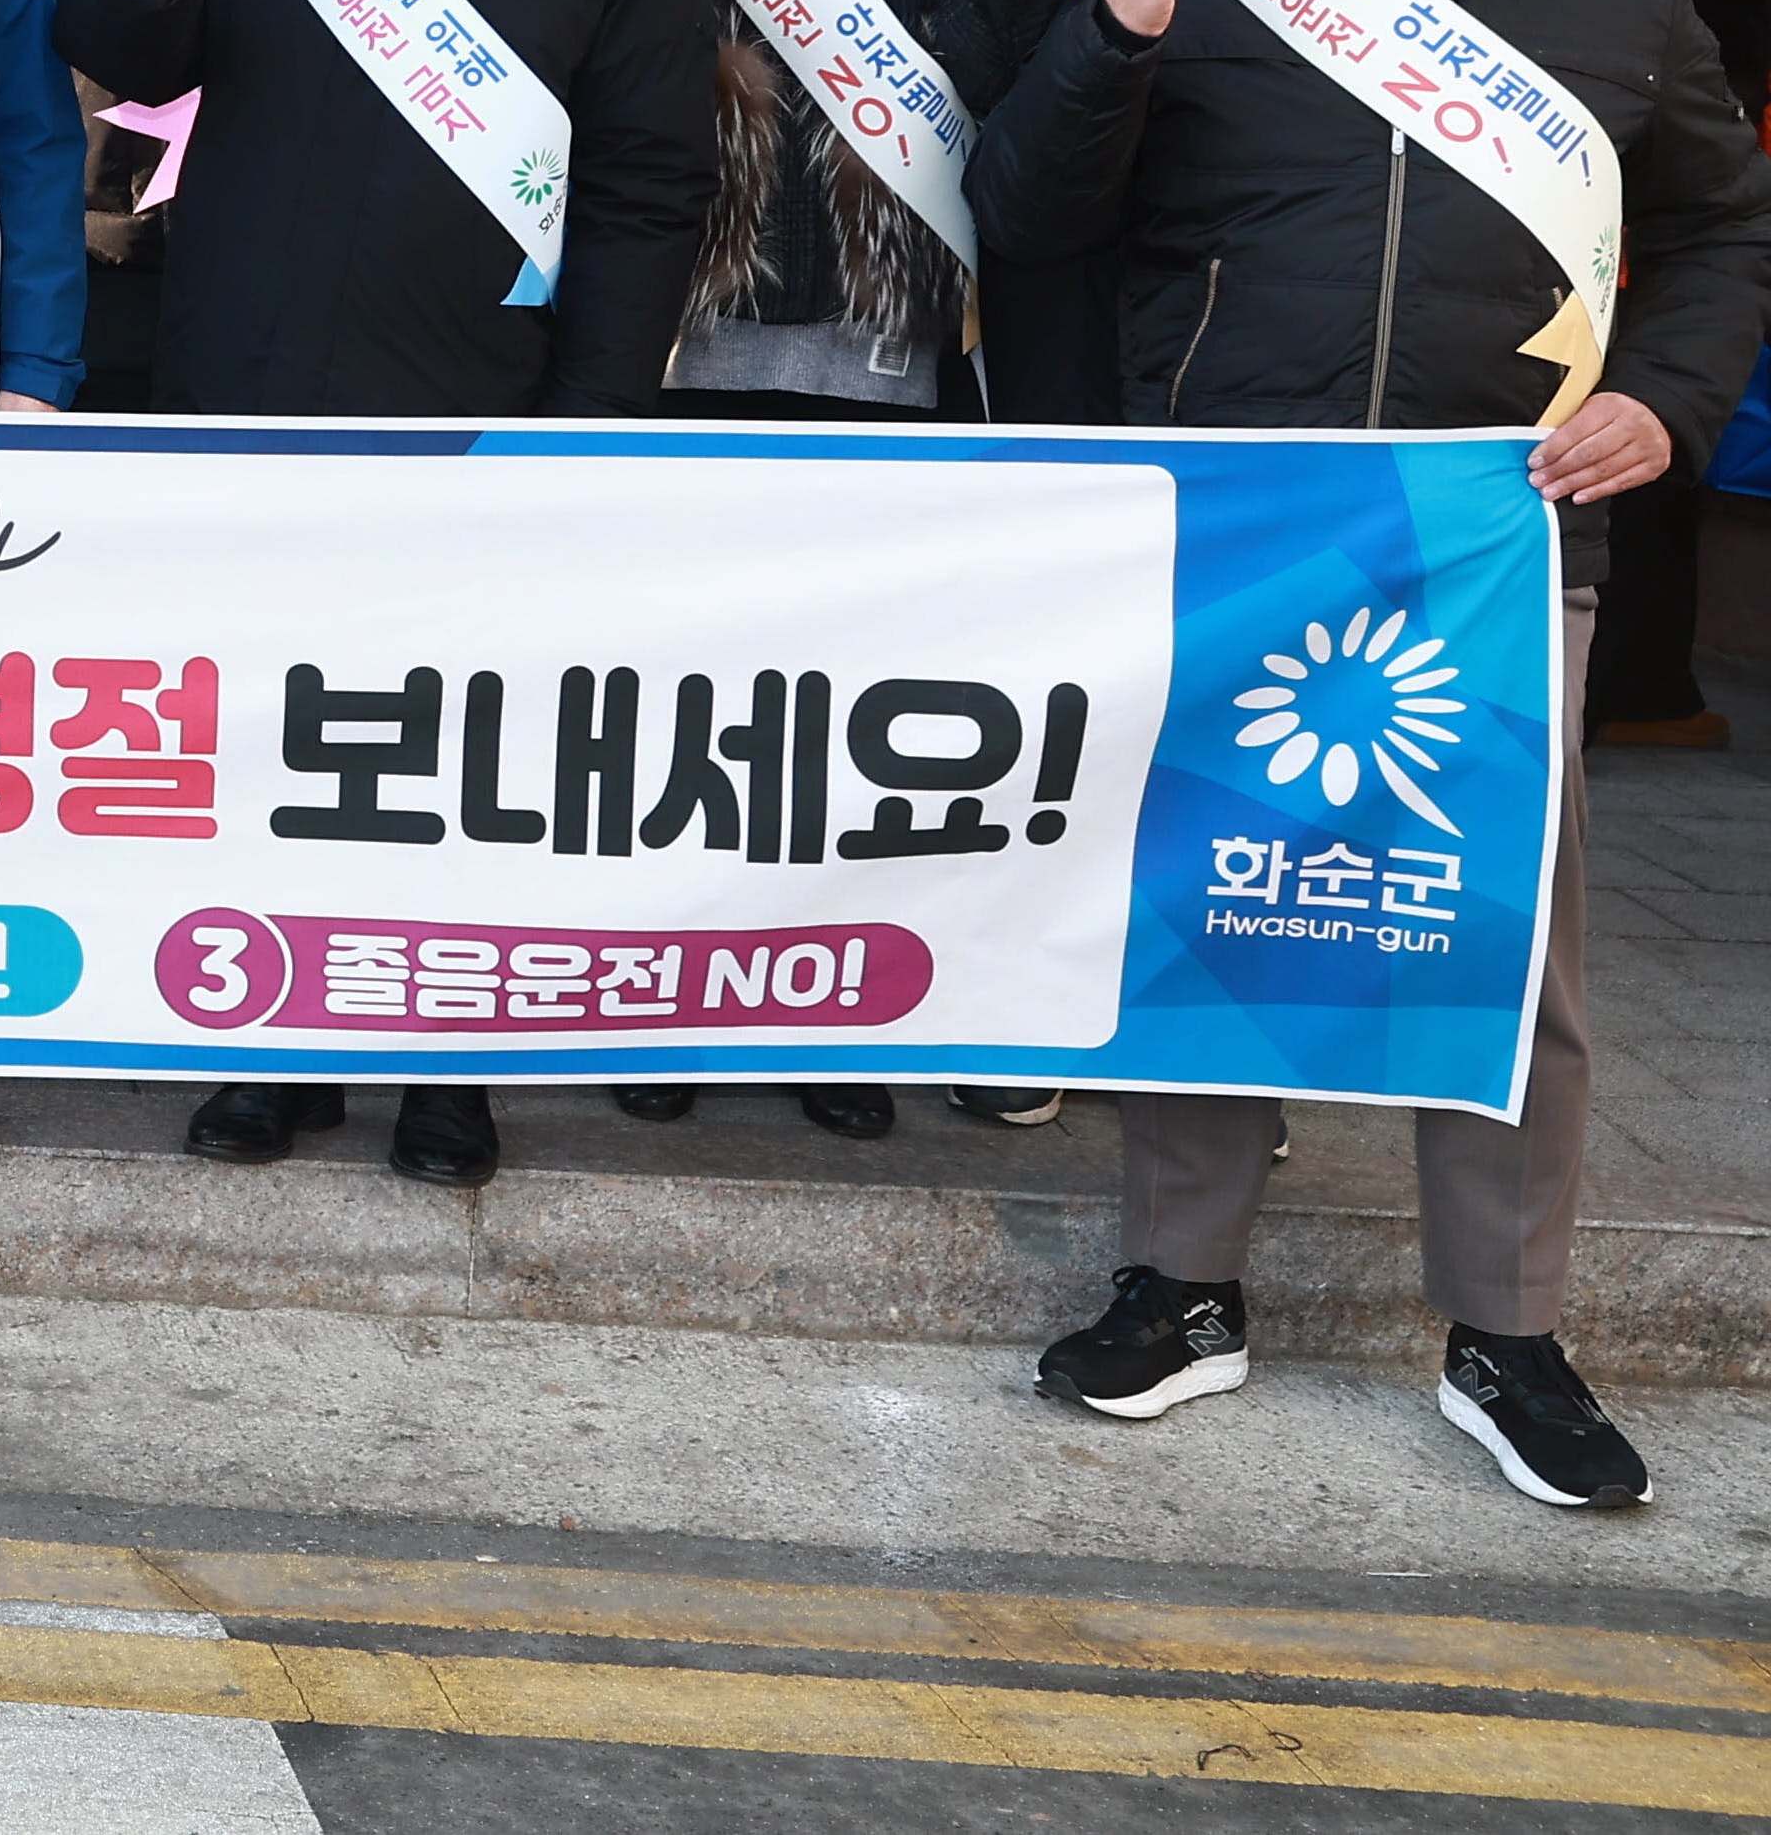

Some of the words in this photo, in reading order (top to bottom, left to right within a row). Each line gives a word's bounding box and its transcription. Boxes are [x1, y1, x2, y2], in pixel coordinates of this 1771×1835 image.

[425, 9, 509, 87] 위해
[403, 65, 486, 142] 금지
[816, 54, 912, 167] NO!
[1381, 62, 1513, 174] NO!
[1393, 1, 1595, 188] 안전벨트!
[269, 661, 1088, 866] 보내세요!
[1206, 835, 1462, 922] 화순군
[1205, 909, 1451, 953] Hwasun-gun
[322, 933, 679, 1020] 졸음운전
[702, 938, 867, 1010] NO!
